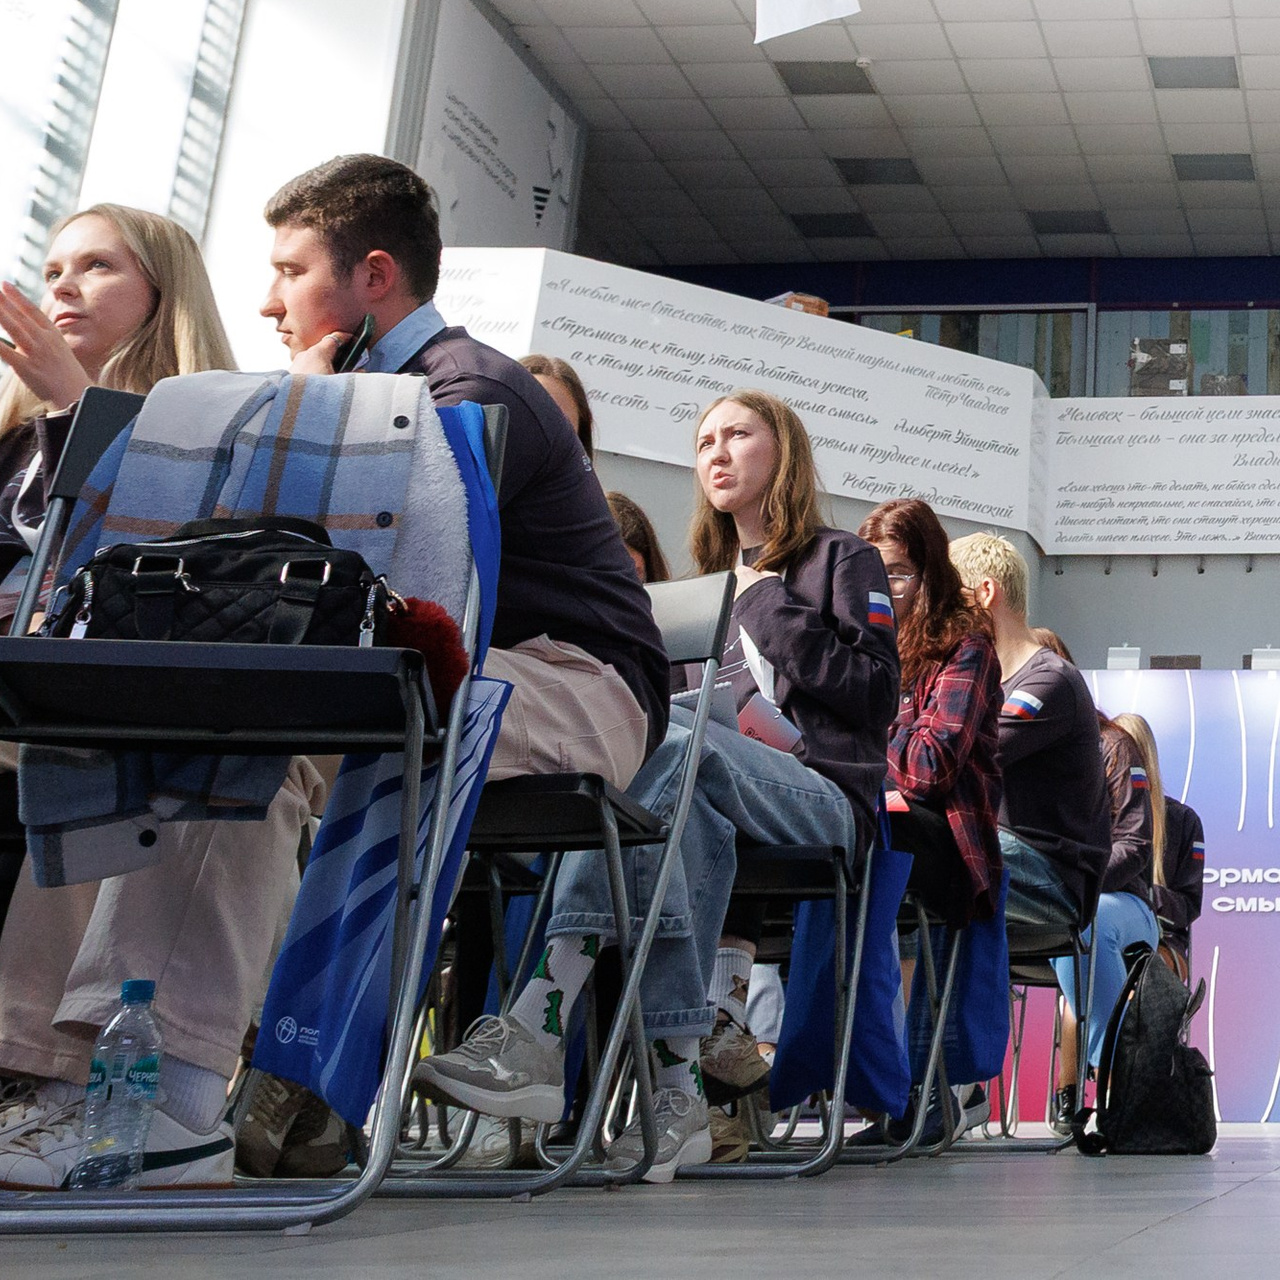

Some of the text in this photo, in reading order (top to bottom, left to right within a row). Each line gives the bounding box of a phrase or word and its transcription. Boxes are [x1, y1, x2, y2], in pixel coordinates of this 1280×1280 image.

[541, 315, 870, 402] «Стремись не к тому, чтобы добиться успеха,
[730, 322, 756, 340] как
[796, 335, 856, 360] Великий
[856, 352, 900, 373] научил
[901, 364, 935, 379] меня
[936, 372, 985, 393] любить
[570, 349, 734, 393] а к тому, чтобы твоя
[611, 393, 649, 411] есть
[959, 392, 1010, 416] Чаадаев
[827, 407, 878, 426] смысл»
[1057, 405, 1123, 422] «Человек
[1140, 405, 1204, 423] большой
[1206, 409, 1243, 424] цели
[893, 417, 1020, 458] Альберт Эйнштейн
[1056, 431, 1123, 447] Большая
[1127, 434, 1161, 448] цель
[1178, 433, 1205, 444] она
[1209, 433, 1228, 444] за
[860, 442, 919, 466] труднее
[921, 458, 931, 468] и
[842, 471, 1014, 520] Роберт Рождественский
[1211, 483, 1224, 491] не
[1225, 480, 1256, 491] бойся
[1187, 499, 1200, 508] не
[1256, 498, 1275, 507] что
[1151, 515, 1171, 525] что
[1172, 516, 1192, 525] они
[1193, 514, 1239, 527] станут
